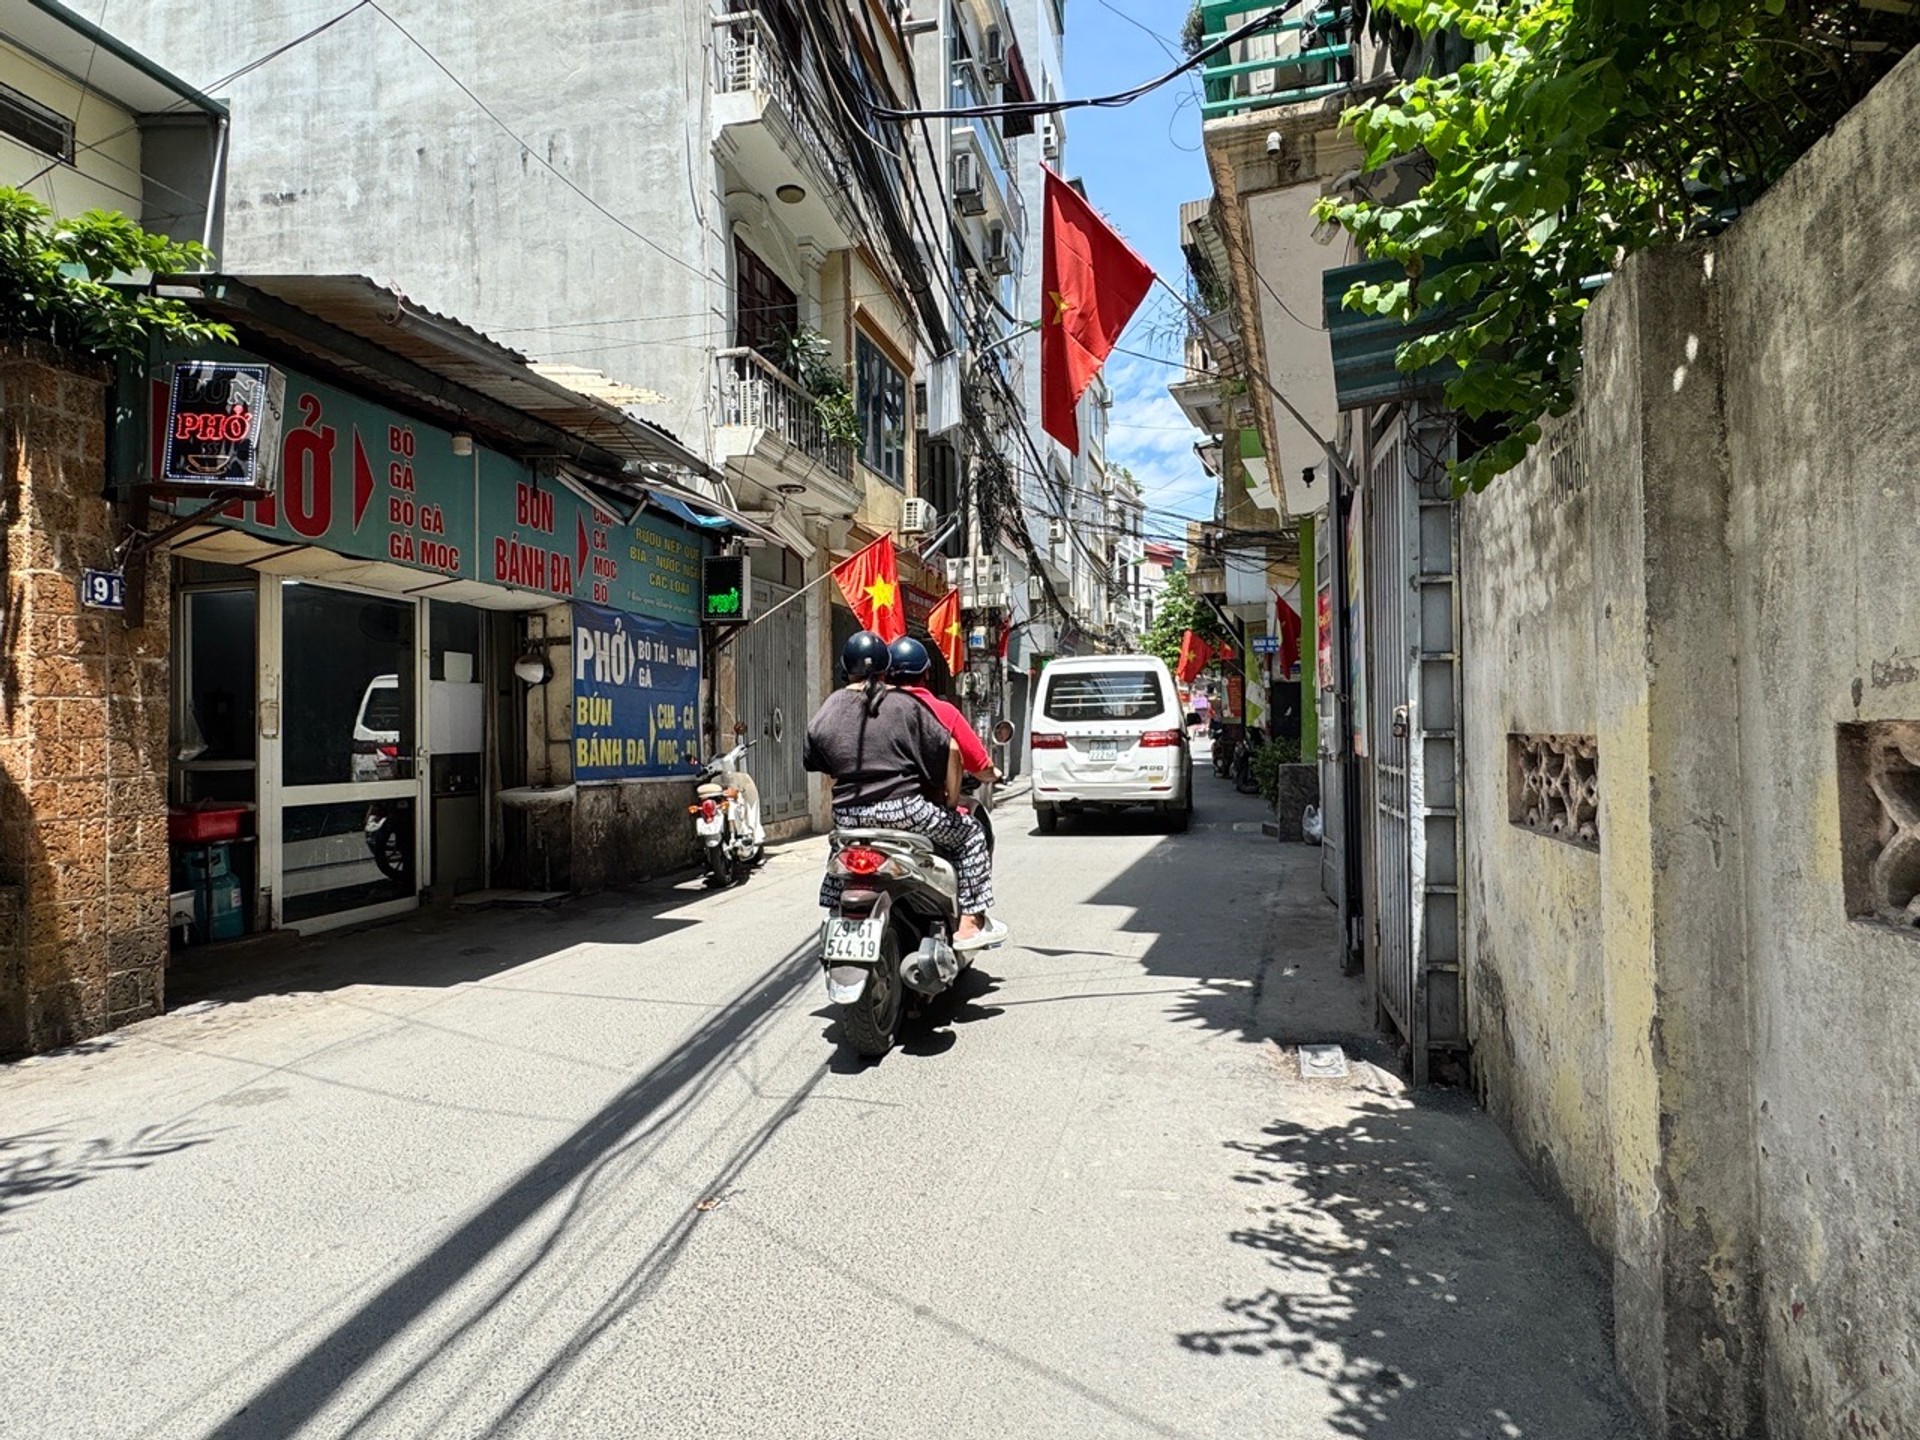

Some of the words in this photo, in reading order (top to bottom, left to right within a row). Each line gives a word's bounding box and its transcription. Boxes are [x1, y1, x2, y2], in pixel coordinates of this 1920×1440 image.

[176, 405, 253, 441] PHỞ
[389, 425, 416, 458] BÒ
[389, 460, 415, 494] GÀ
[389, 494, 415, 528] BÒ
[420, 503, 445, 536] GÀ
[389, 531, 416, 563] GÀ
[420, 539, 460, 574] MỌC
[494, 531, 546, 591] BÁNH
[550, 551, 573, 597] ĐA
[576, 617, 627, 685] PHỞ
[653, 637, 668, 664] TÁI
[638, 664, 652, 688] GÀ
[577, 691, 612, 726] BÚN
[657, 703, 676, 730] CUA
[576, 732, 622, 767] BÁNH
[626, 739, 646, 766] ĐA
[827, 939, 875, 958] 544.19
